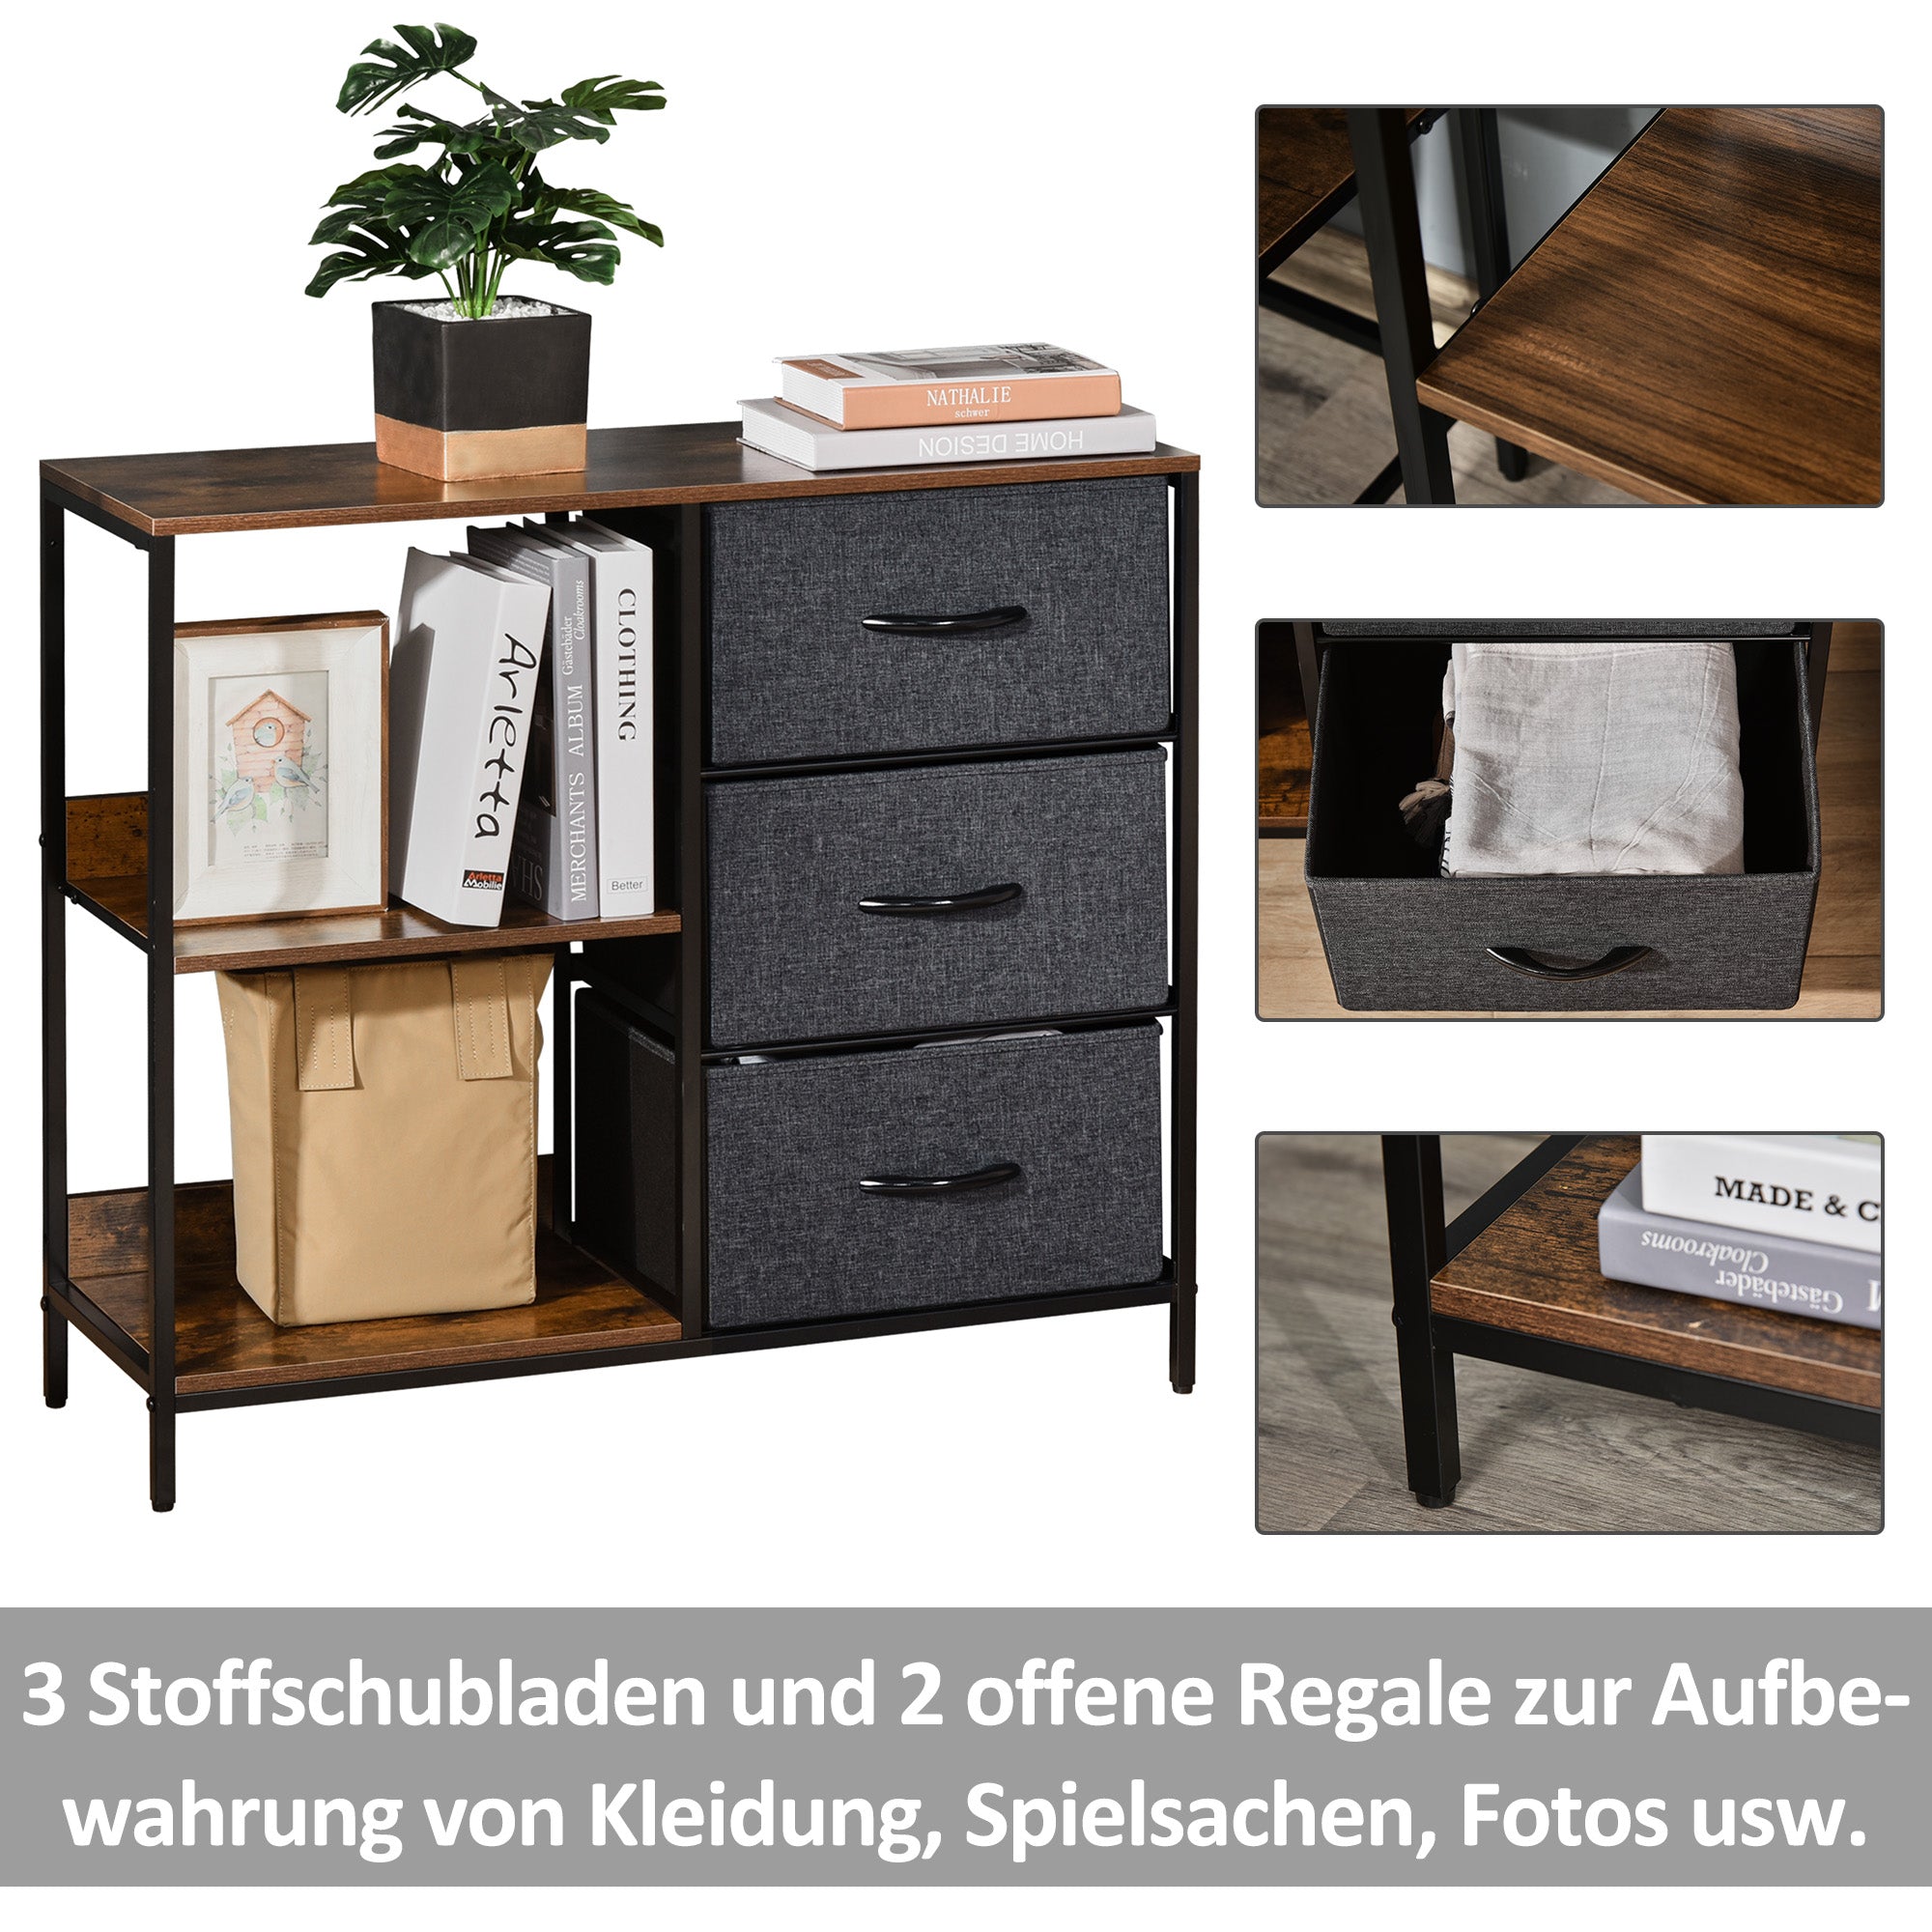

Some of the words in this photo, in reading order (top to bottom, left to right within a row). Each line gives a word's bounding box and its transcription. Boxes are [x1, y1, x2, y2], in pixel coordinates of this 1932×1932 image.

[926, 385, 1011, 407] NATHALIE
[954, 407, 990, 418] schwer
[1014, 430, 1084, 453] HOME
[573, 580, 585, 641] Cloakrooms
[560, 615, 574, 676] Gästebäder
[617, 587, 637, 743] CLOTHING
[473, 633, 538, 839] Arletta
[567, 684, 583, 757] ALBUM
[568, 772, 587, 902] MERCHANTS
[611, 880, 643, 891] Better
[1714, 1175, 1814, 1212] MADE
[1823, 1194, 1846, 1218] &
[1640, 1230, 1770, 1275] Cloakrooms
[1714, 1269, 1844, 1315] Gästebäder
